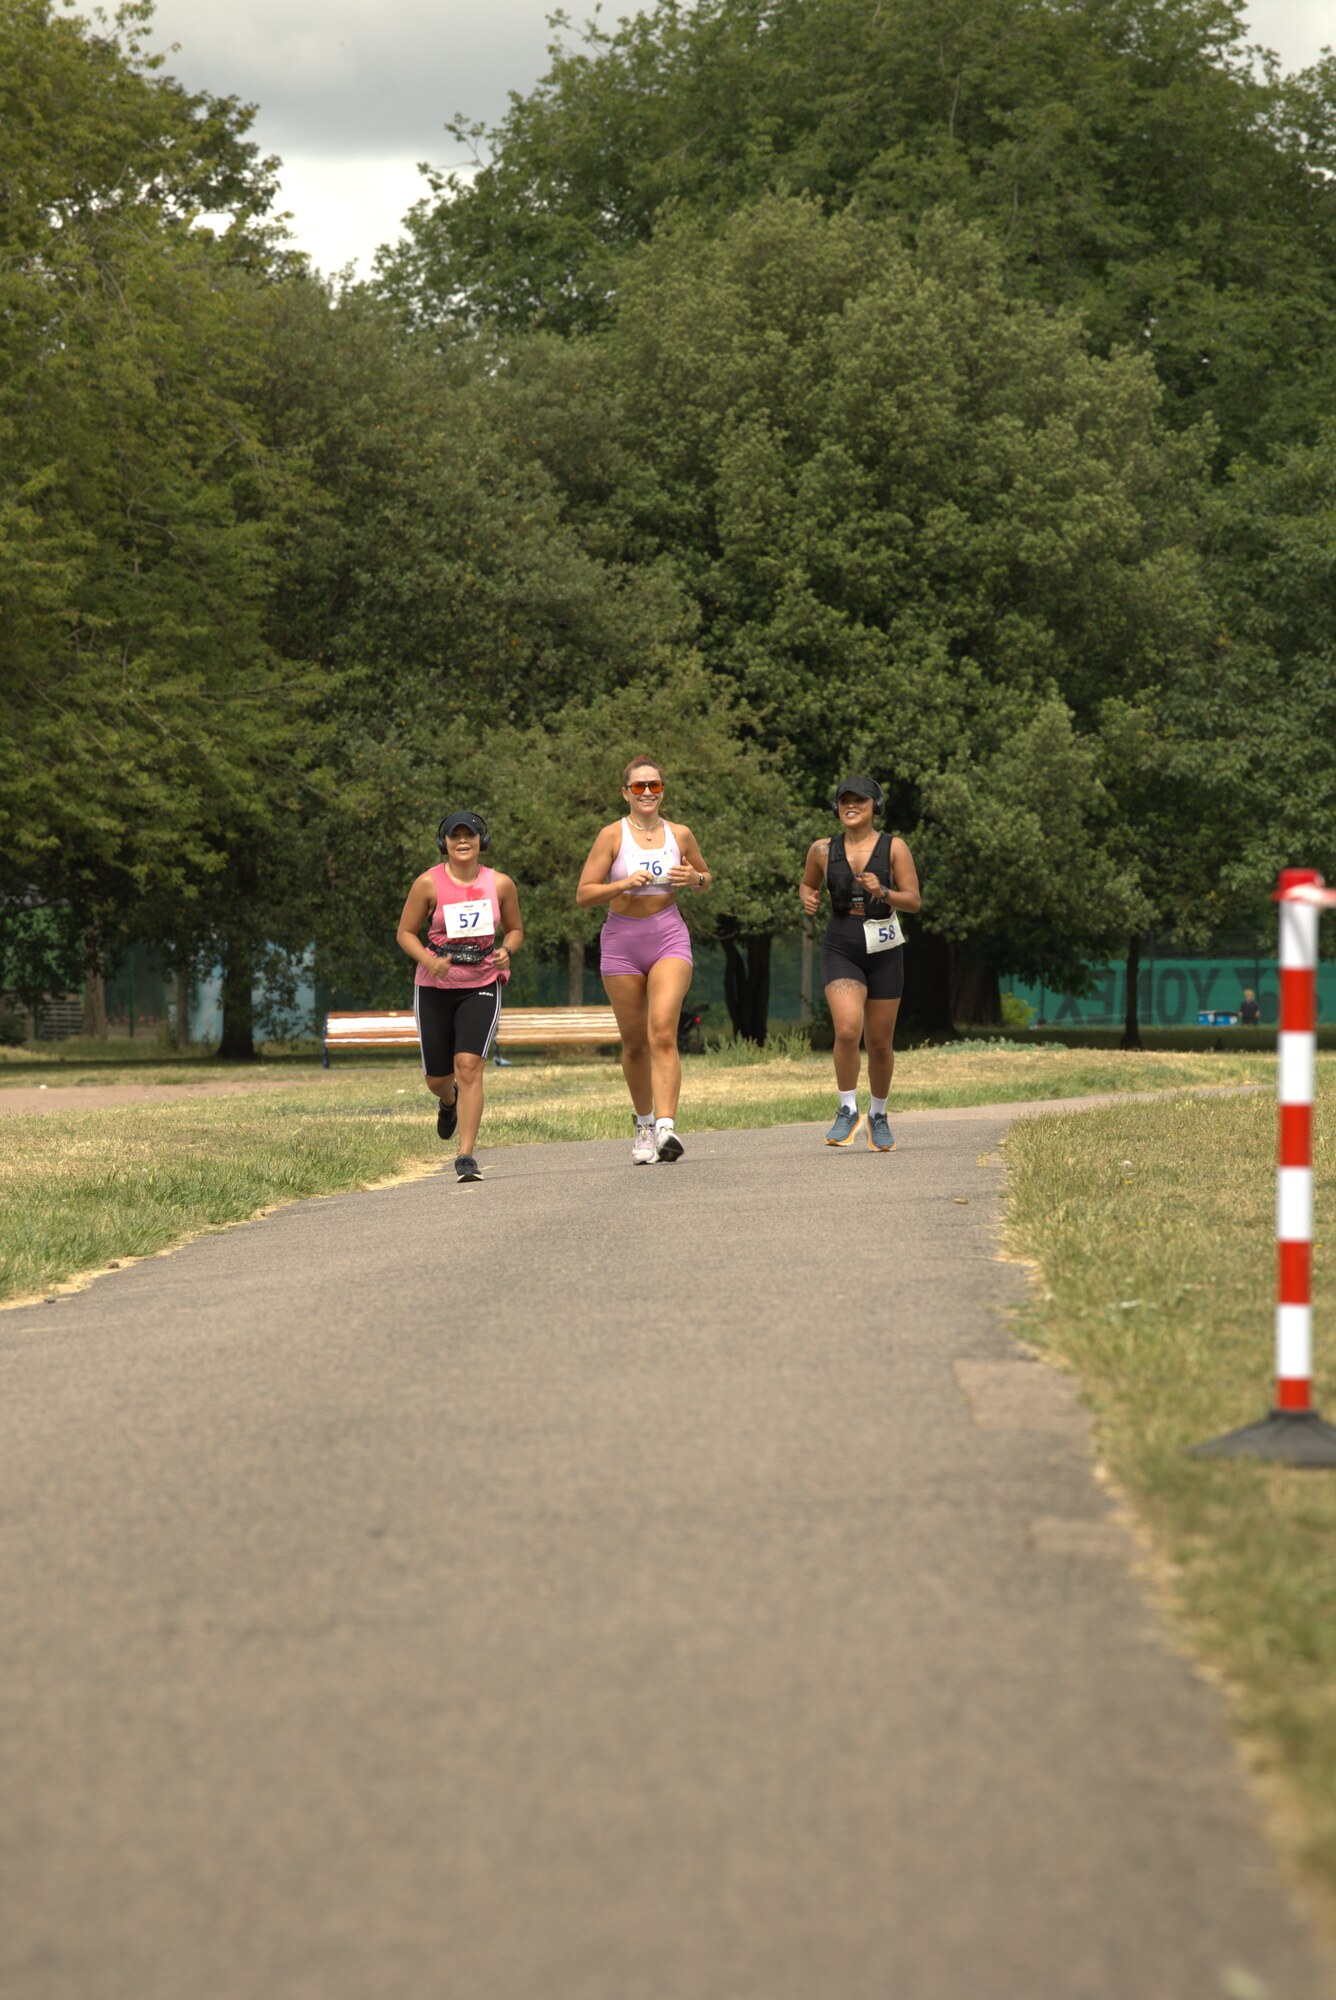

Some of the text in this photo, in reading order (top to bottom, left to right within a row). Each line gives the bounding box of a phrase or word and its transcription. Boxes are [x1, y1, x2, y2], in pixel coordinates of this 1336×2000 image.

[639, 860, 663, 876] 76
[459, 912, 480, 929] 57
[878, 924, 896, 943] 58
